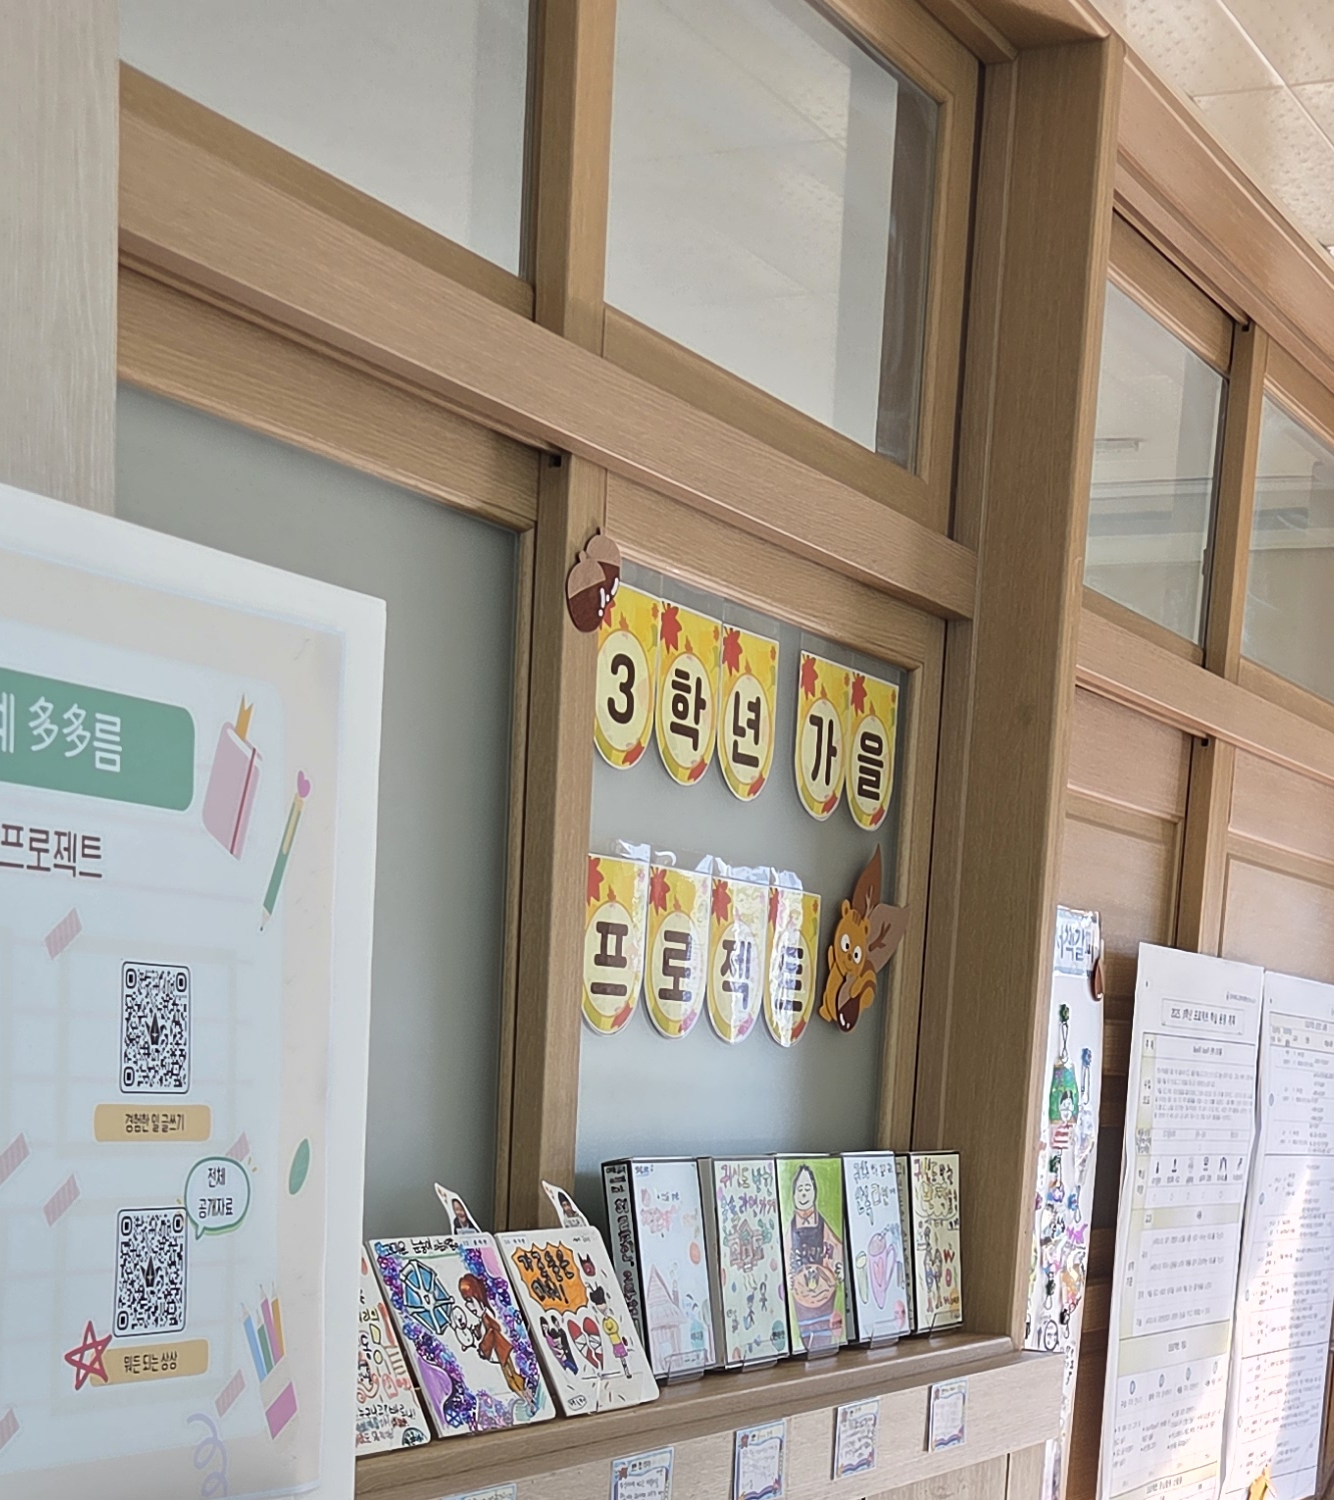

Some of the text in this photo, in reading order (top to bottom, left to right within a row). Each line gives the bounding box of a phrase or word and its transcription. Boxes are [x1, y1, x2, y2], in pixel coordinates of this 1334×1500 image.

[28, 696, 123, 773] 多多름
[607, 653, 761, 769] 3학년
[809, 713, 884, 802] 가을
[590, 920, 803, 1012] 프로젝트
[125, 1114, 184, 1132] 경험한 일 글쓰기
[208, 1167, 225, 1187] 전체
[198, 1198, 233, 1218] 공개자료
[124, 1352, 177, 1373] 뭐든 되는 상상
